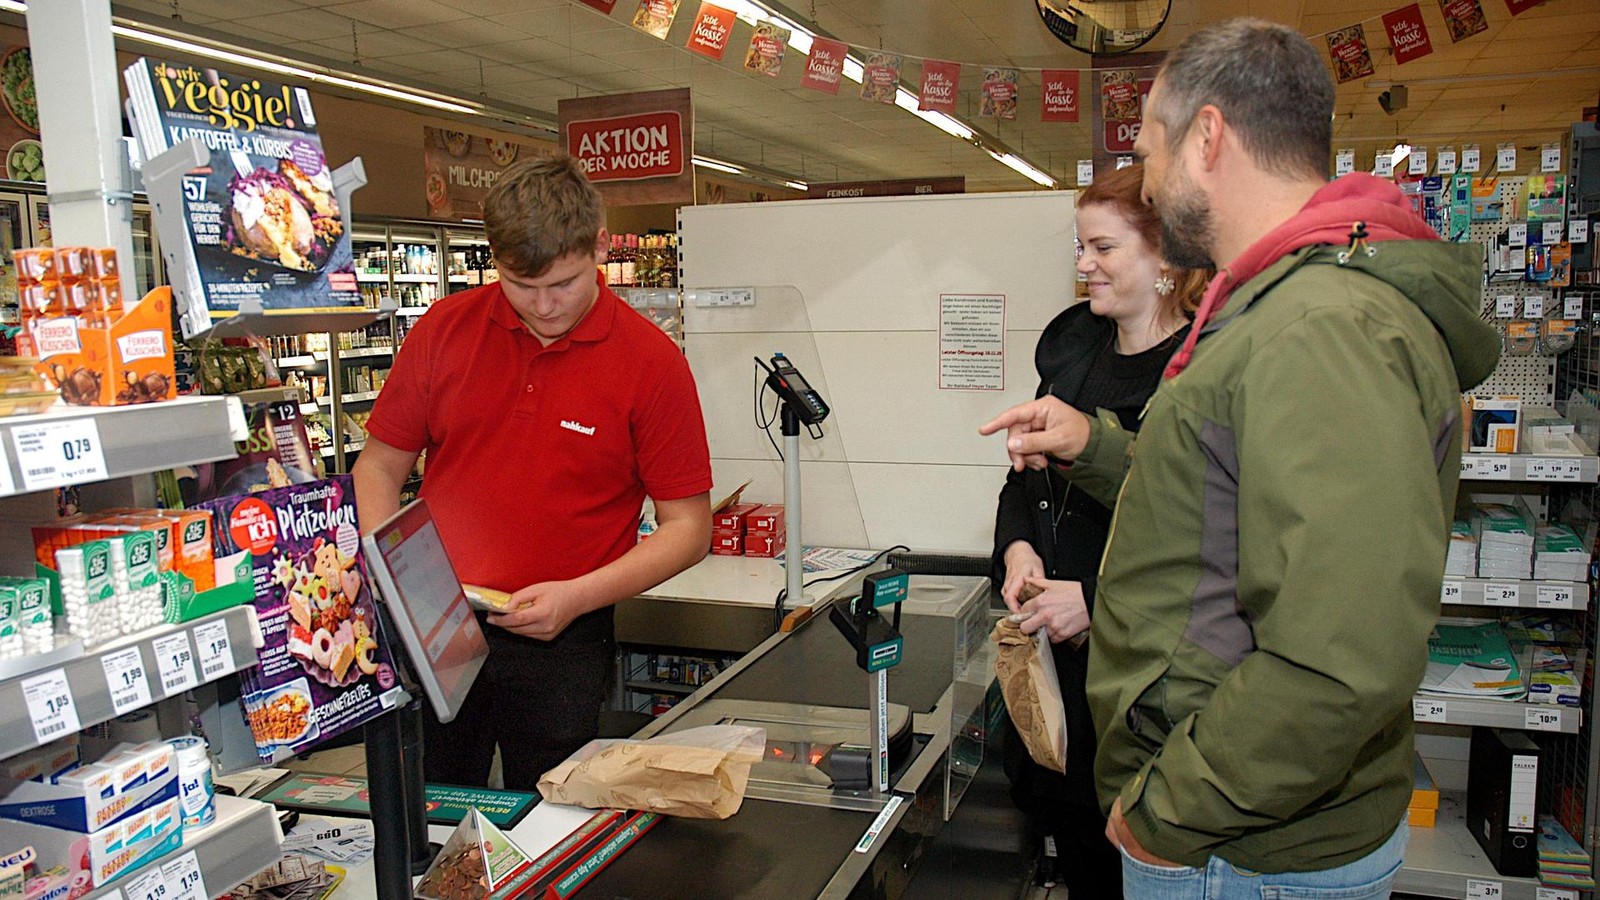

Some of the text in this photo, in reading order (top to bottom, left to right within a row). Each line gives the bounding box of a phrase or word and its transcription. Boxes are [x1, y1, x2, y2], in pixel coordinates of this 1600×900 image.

[695, 23, 723, 42] Kasse
[1393, 30, 1420, 46] Kasse
[154, 62, 202, 82] slowly
[809, 59, 836, 75] Kasse
[923, 82, 952, 97] Kasse
[1045, 92, 1073, 105] Kasse
[578, 125, 668, 156] AKTION
[241, 136, 252, 154] &
[252, 135, 294, 161] KÜRBIS
[578, 150, 671, 174] DER WOCHE
[182, 176, 207, 200] 57
[826, 188, 865, 198] FEINKOST
[914, 185, 933, 194] BIER
[40, 326, 73, 338] FERRERO
[40, 340, 77, 351] KÜSSCHEN
[127, 336, 160, 346] FERRERO
[126, 346, 163, 355] KÜSSCHEN
[278, 404, 296, 420] 12
[289, 482, 338, 505] Traumhafte
[240, 505, 260, 517] meine
[247, 513, 277, 541] ich
[275, 499, 356, 541] Plätzchen
[185, 528, 204, 540] tac
[187, 521, 203, 535] tic
[134, 543, 150, 556] tic
[90, 554, 107, 568] tic
[131, 552, 150, 566] tac
[89, 562, 106, 577] tac
[26, 591, 40, 603] tic
[21, 600, 41, 610] tac
[308, 684, 371, 723] GESCHNETZELTES
[182, 779, 199, 796] ja!
[477, 799, 518, 807] Coupons
[20, 804, 56, 817] DEXTROSE
[38, 884, 68, 900] ntos
